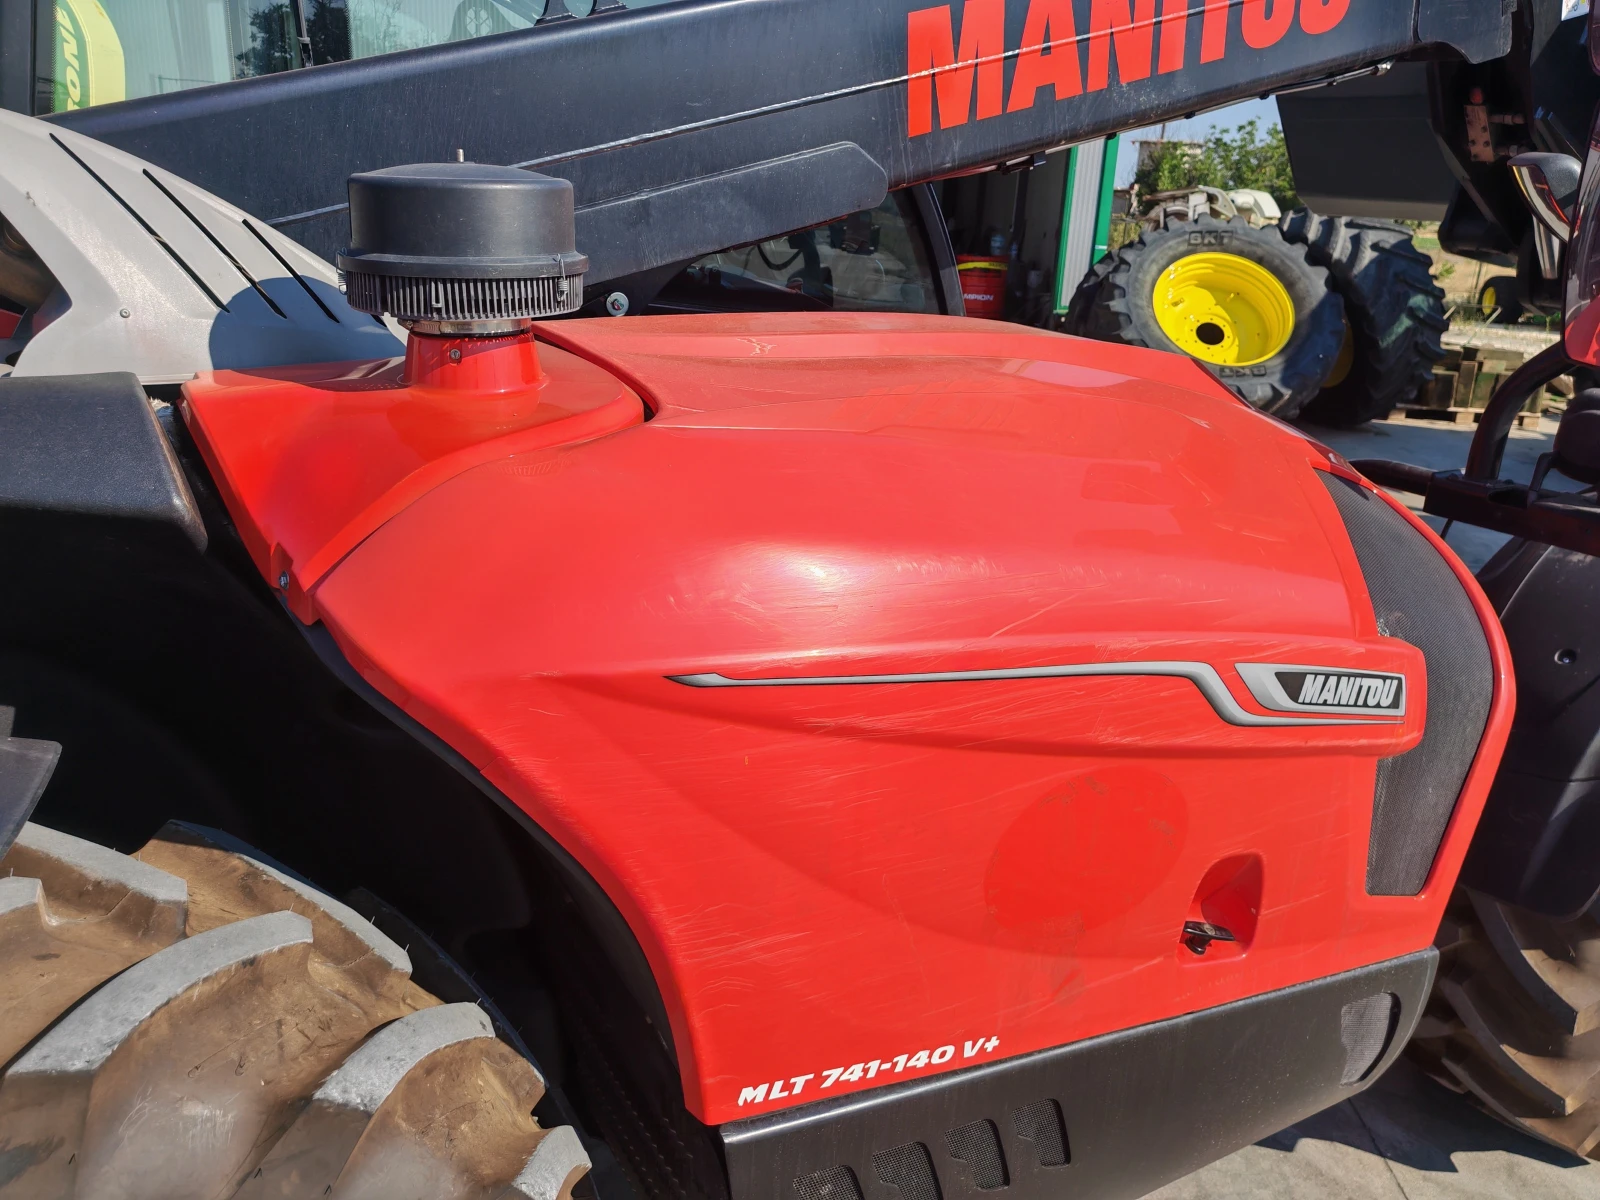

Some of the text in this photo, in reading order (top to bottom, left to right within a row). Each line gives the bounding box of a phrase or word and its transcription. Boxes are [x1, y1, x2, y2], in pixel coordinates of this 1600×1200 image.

[907, 0, 1351, 138] MANI
[1297, 673, 1399, 707] MANITOU
[737, 1035, 1001, 1107] MLT 741-140 V+
